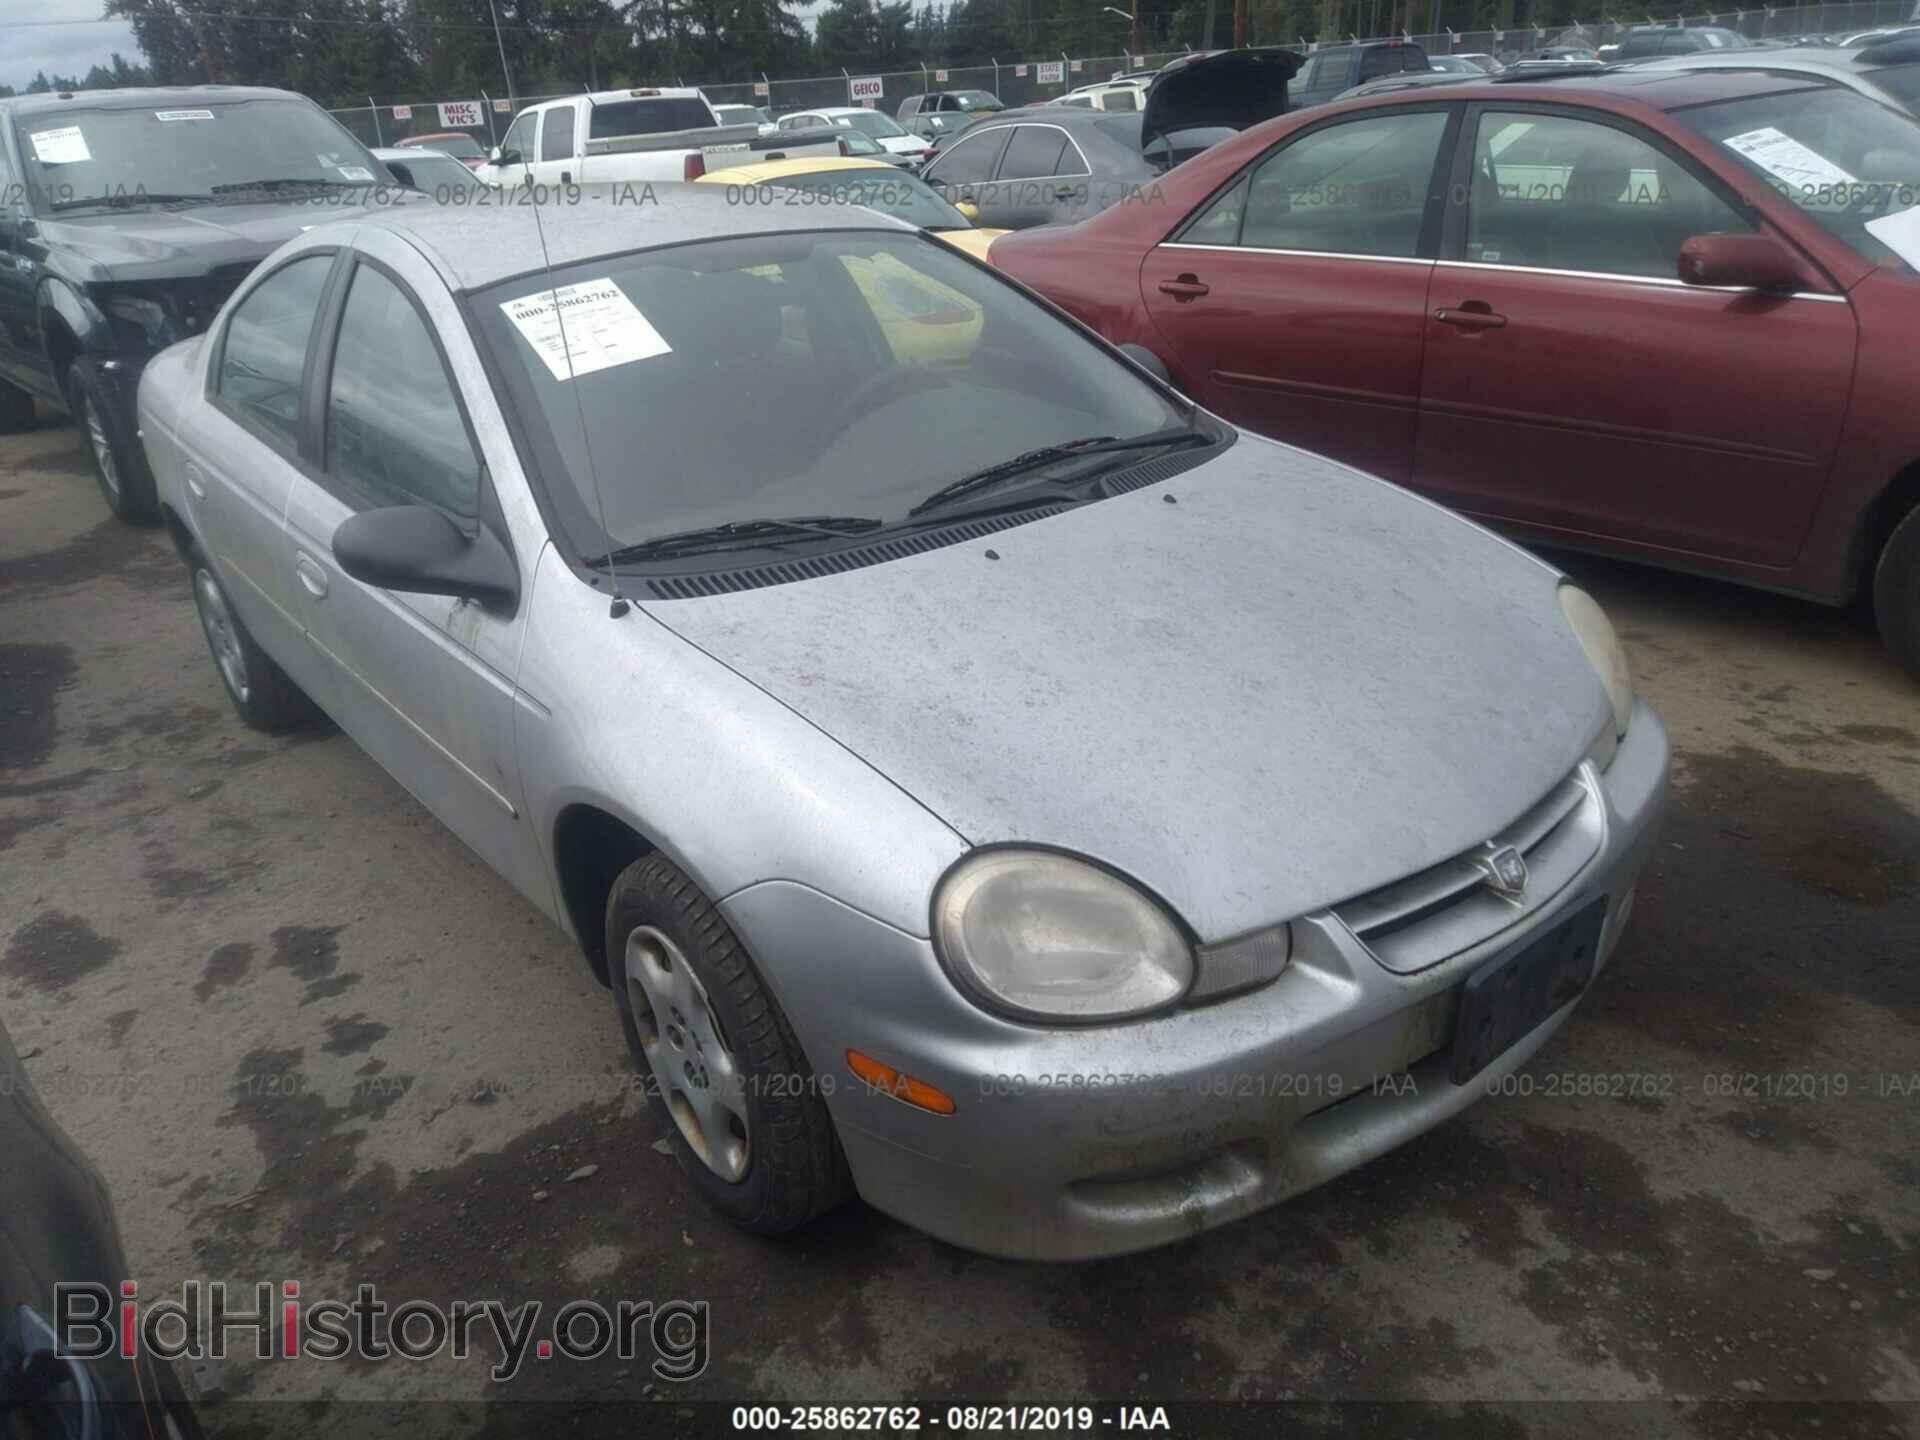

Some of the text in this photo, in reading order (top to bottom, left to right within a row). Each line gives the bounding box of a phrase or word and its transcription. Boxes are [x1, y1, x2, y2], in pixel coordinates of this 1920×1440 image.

[853, 82, 880, 96] GEICO
[444, 103, 478, 115] MISC.
[447, 114, 477, 125] VIC'S
[515, 289, 620, 321] 000-25862762
